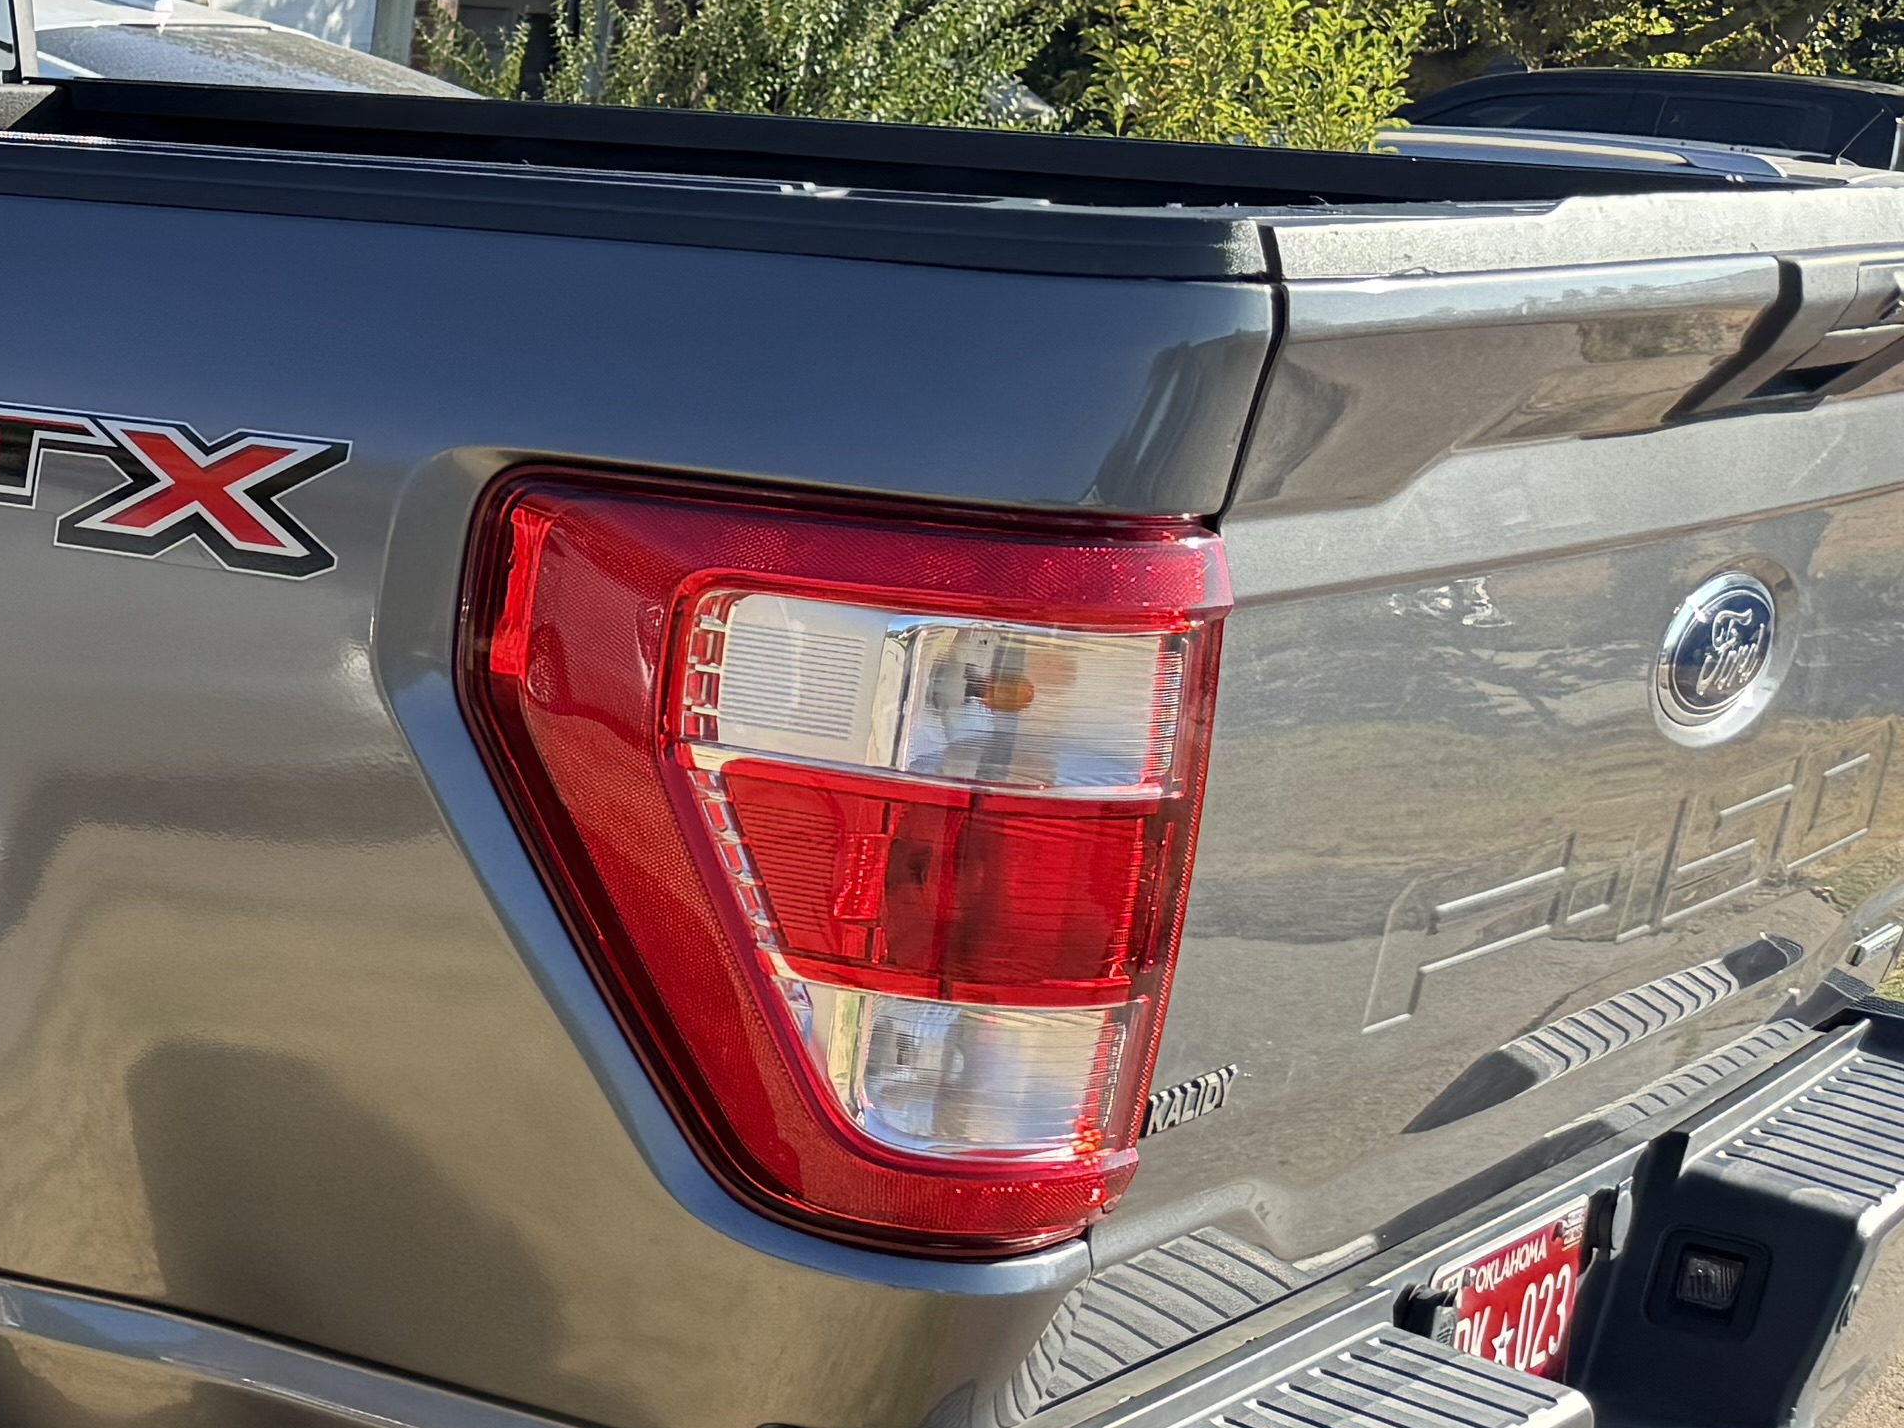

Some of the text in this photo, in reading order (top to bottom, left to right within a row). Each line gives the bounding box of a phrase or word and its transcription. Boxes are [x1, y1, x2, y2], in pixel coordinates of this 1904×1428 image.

[1696, 608, 1765, 695] Ford
[1474, 1233, 1547, 1294] OKLAHOMA
[1515, 1263, 1571, 1372] 023
